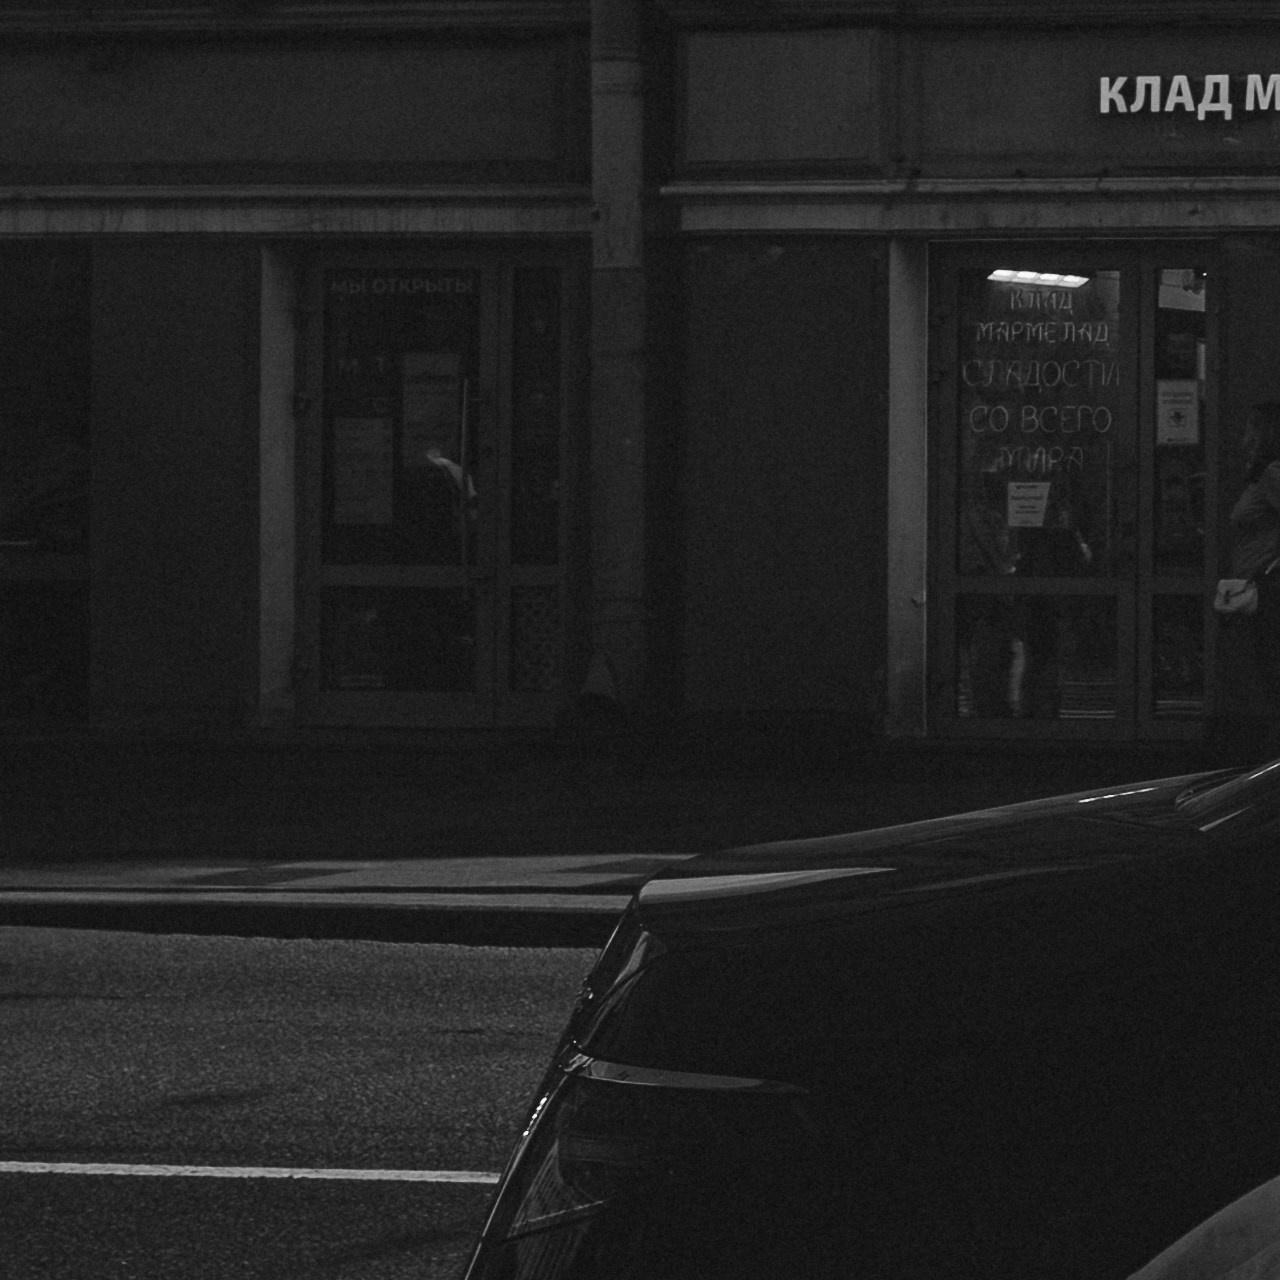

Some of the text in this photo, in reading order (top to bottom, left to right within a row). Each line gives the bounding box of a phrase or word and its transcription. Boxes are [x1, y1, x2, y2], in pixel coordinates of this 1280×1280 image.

[1099, 75, 1233, 121] КЛАД
[1010, 289, 1074, 316] КЛАД
[975, 321, 1111, 347] МАРМЕЛАД
[961, 359, 1120, 393] СЛАДОСТИ
[968, 404, 1113, 433] СО ВСЕГО
